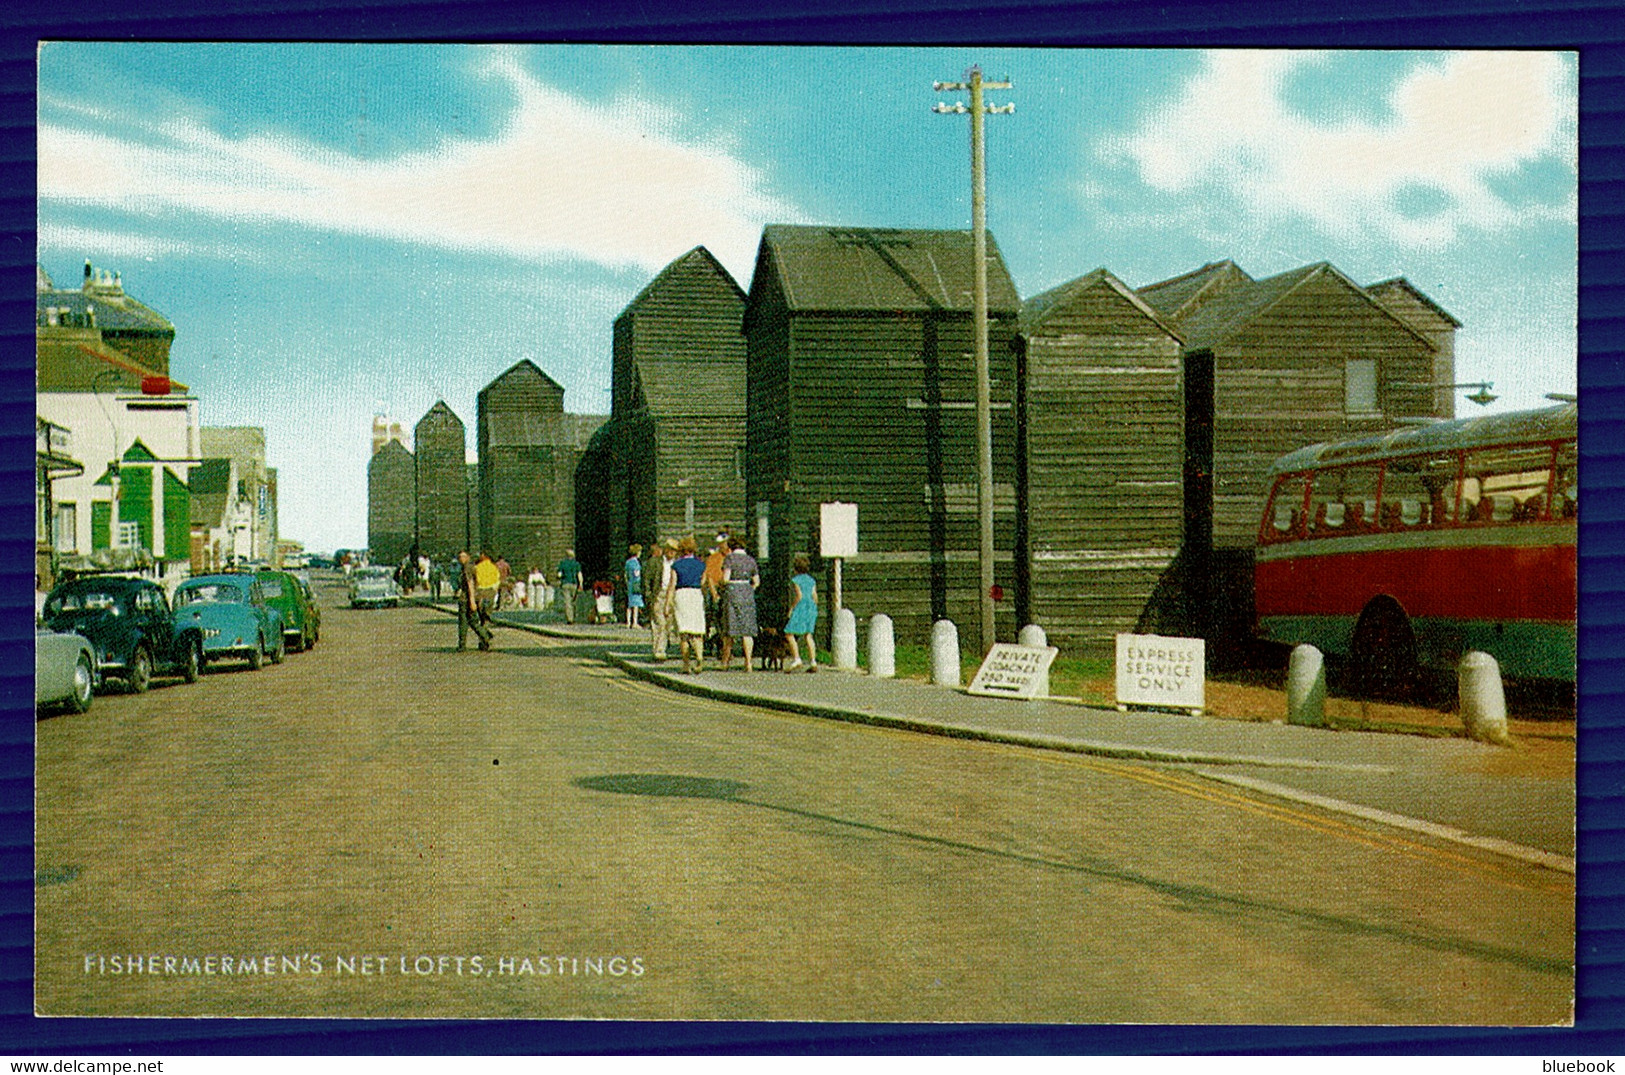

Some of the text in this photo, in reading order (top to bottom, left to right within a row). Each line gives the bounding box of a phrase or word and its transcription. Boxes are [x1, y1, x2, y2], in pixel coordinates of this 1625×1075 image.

[996, 650, 1041, 663] PRIVATE
[1127, 647, 1194, 662] EXPRESS
[1126, 661, 1192, 678] SERVICE
[1139, 677, 1184, 691] ONLY
